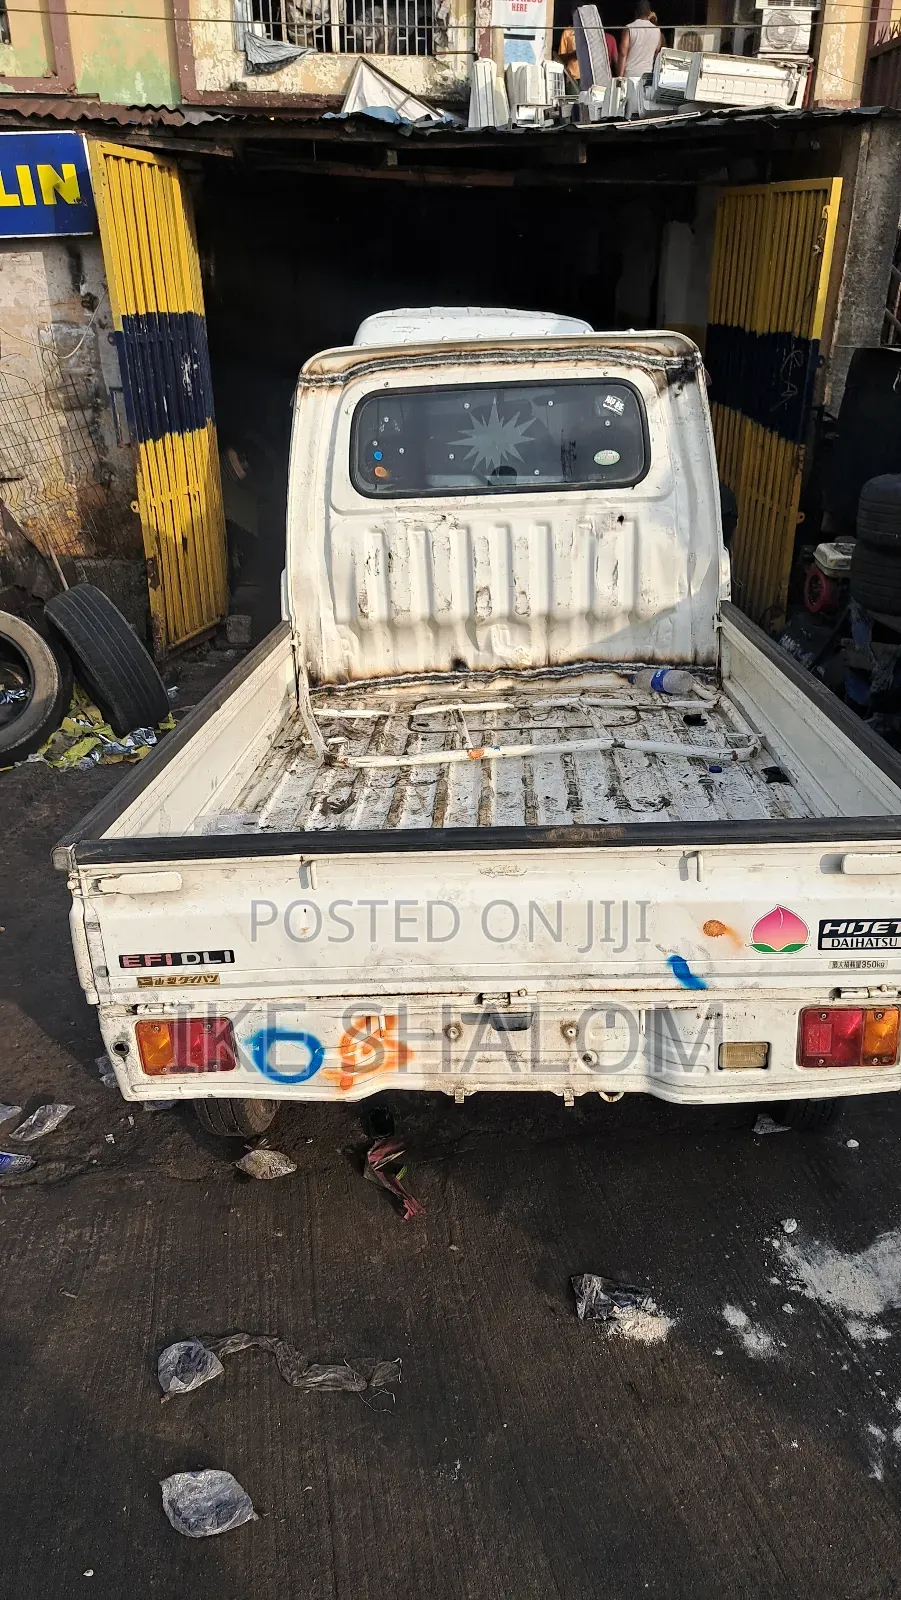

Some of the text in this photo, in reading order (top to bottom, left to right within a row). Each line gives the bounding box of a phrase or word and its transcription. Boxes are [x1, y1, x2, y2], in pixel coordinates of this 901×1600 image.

[0, 163, 81, 207] LIN
[831, 937, 898, 948] DAIHATSU
[122, 950, 232, 968] EFI DLI
